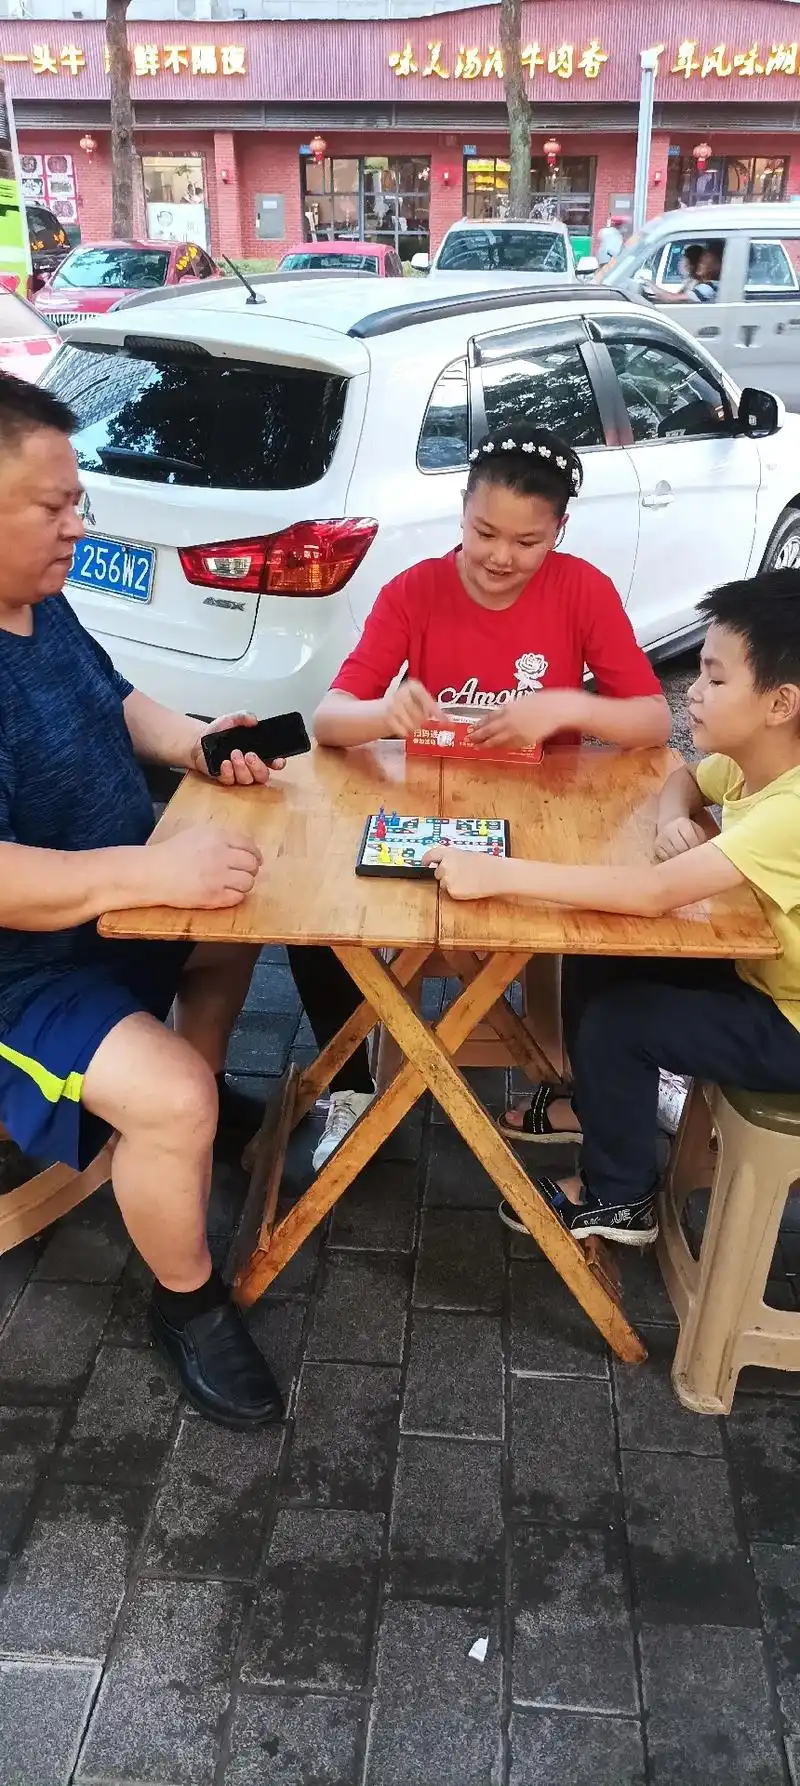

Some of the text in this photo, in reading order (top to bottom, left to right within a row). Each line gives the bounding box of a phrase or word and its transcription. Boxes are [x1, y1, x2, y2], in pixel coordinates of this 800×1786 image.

[3, 43, 247, 76] 一头牛 鲜不隔夜
